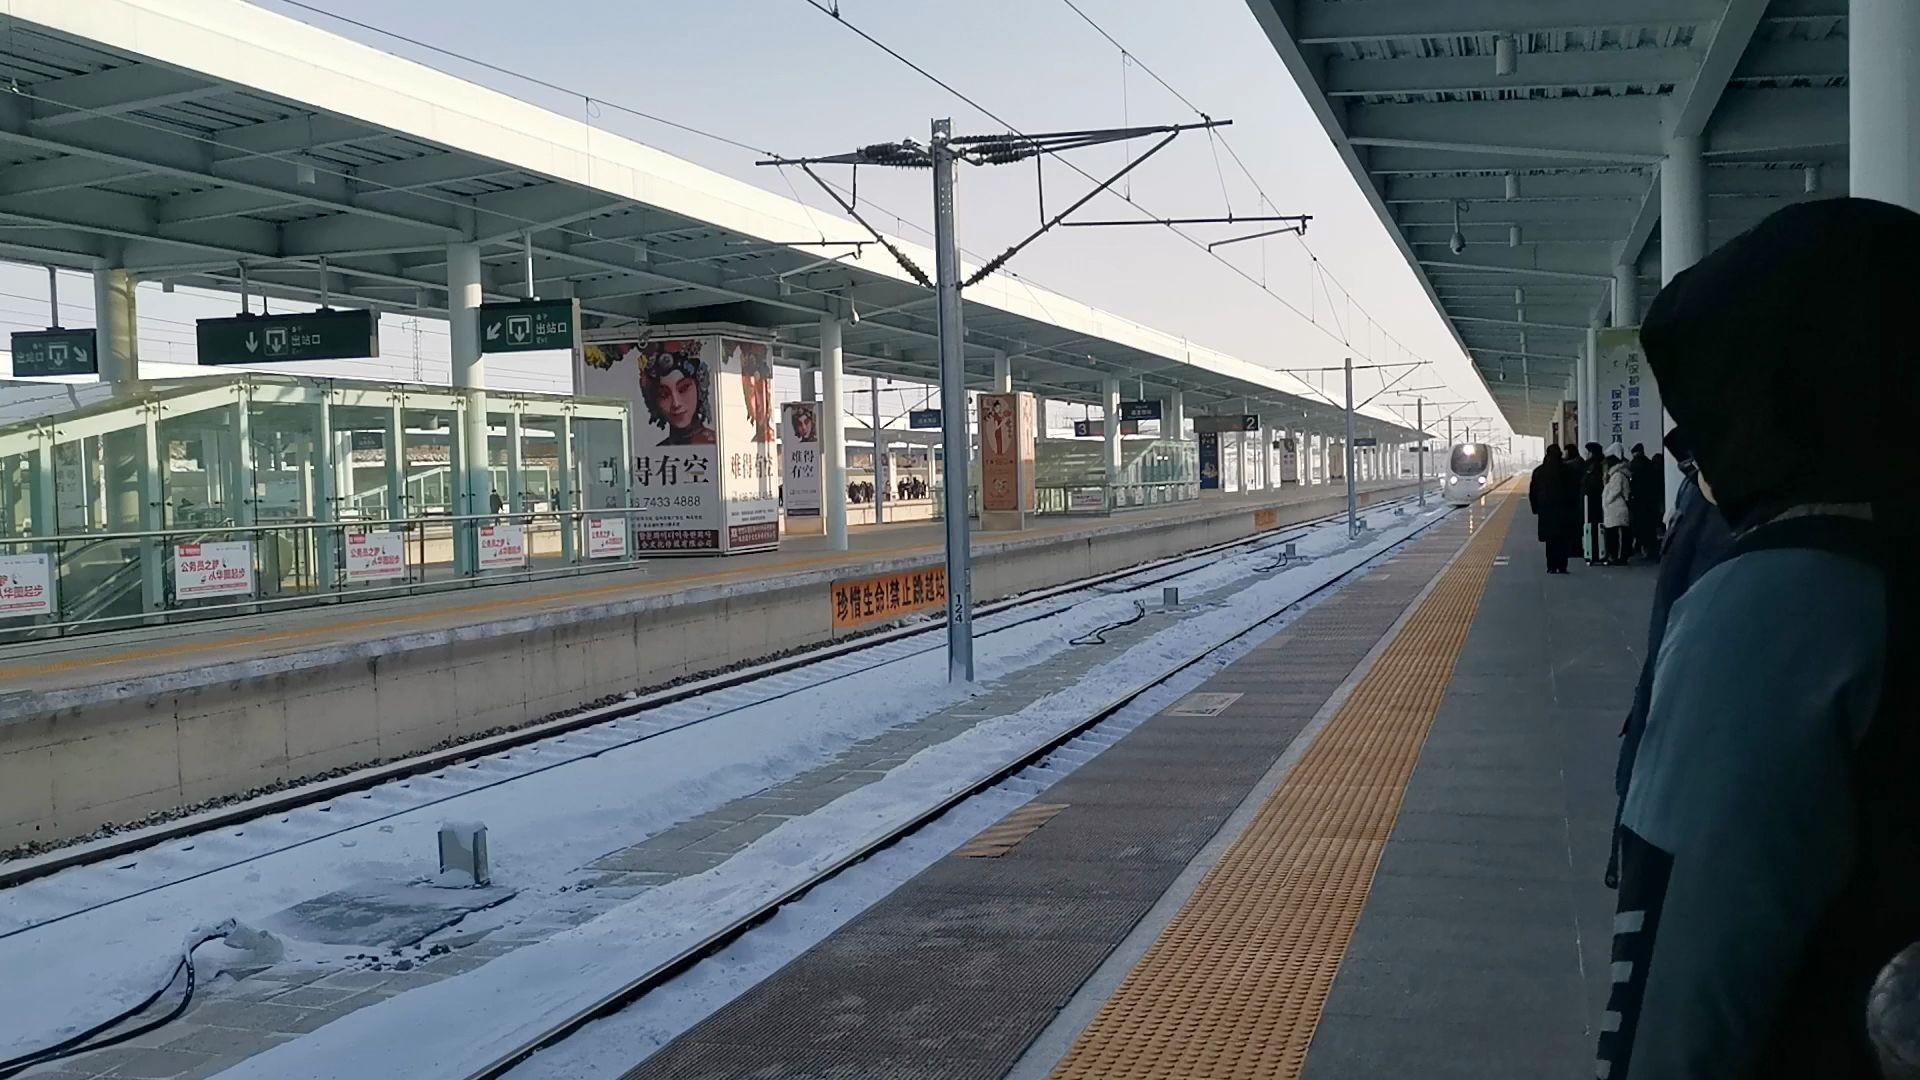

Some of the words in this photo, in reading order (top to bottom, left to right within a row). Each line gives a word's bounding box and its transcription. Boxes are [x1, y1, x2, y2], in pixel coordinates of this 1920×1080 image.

[536, 321, 567, 335] 出站口
[292, 334, 320, 346] 出站口
[1077, 423, 1087, 436] 3
[1245, 416, 1255, 430] 2
[643, 496, 671, 507] 7433
[673, 495, 701, 507] 4888
[955, 594, 963, 622] 124
